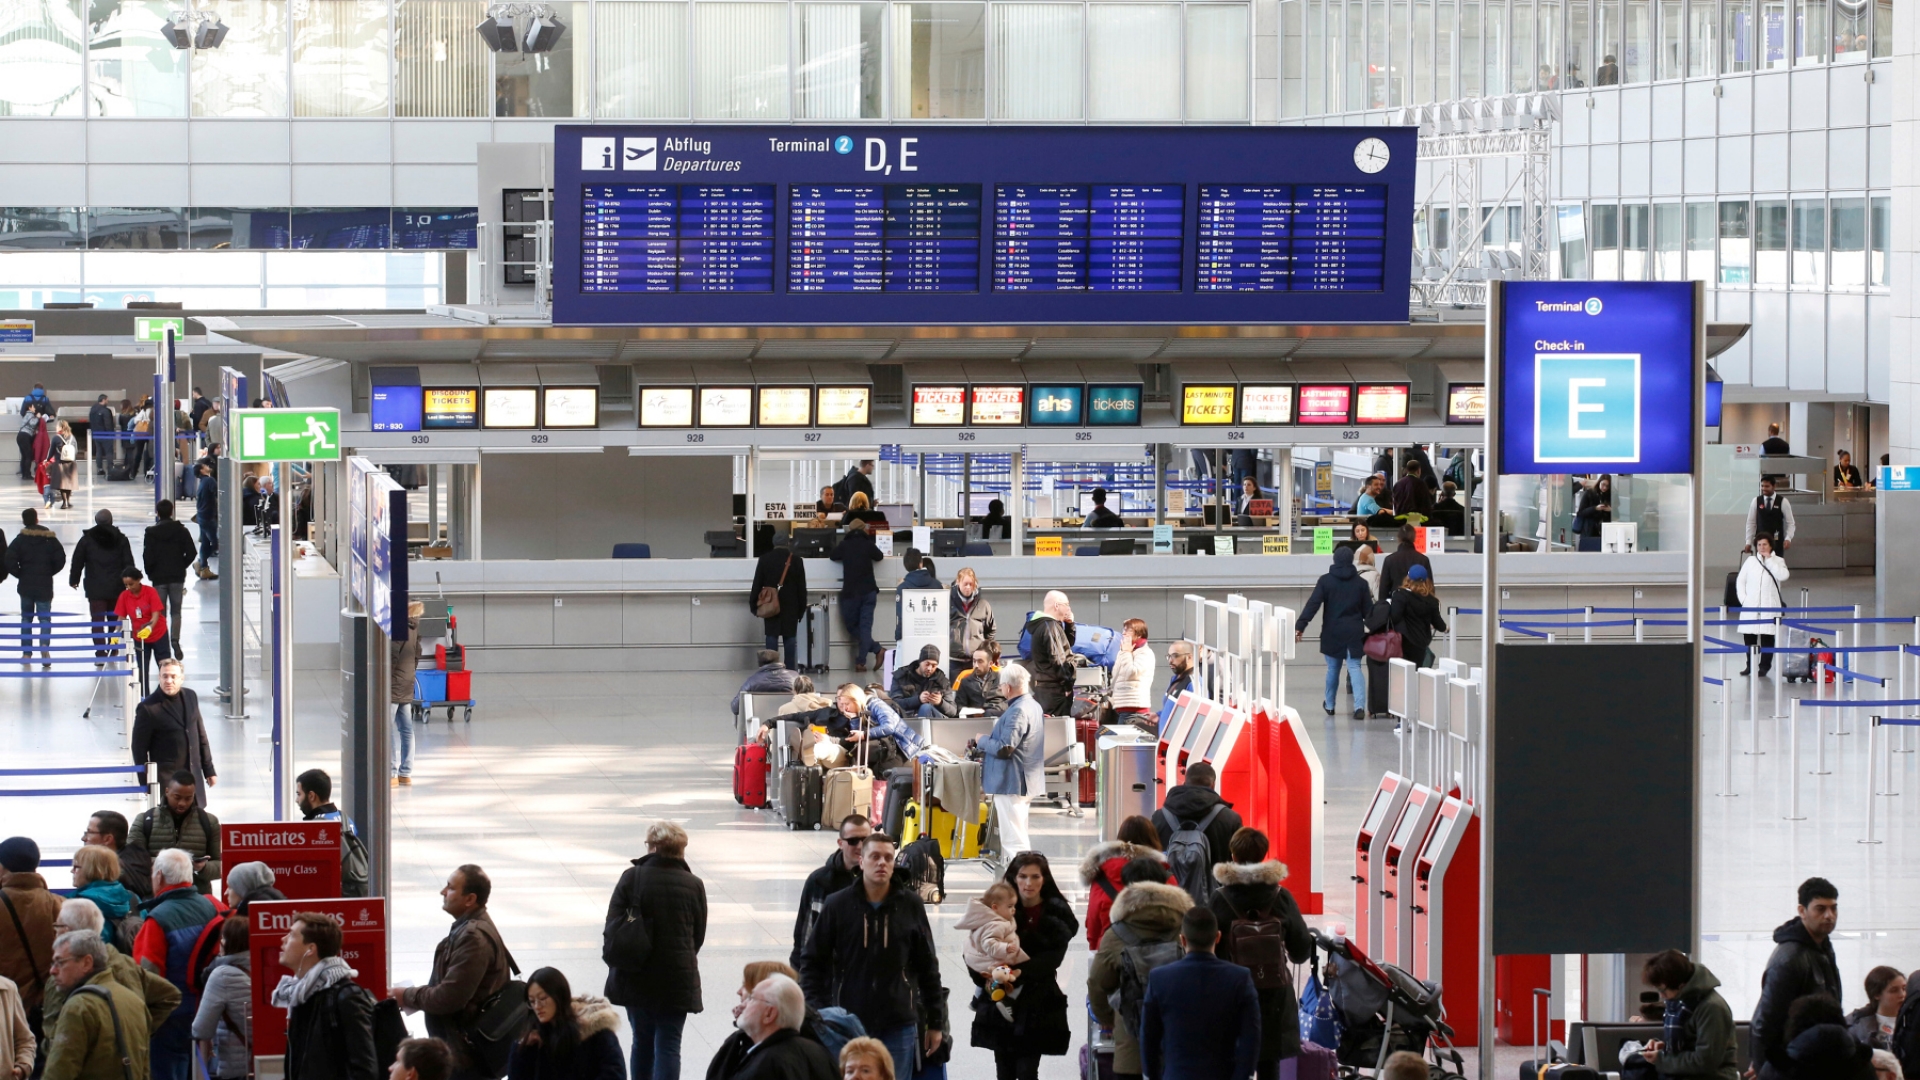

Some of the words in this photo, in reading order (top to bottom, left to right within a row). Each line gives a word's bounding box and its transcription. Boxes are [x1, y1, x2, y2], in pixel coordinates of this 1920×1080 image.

[664, 137, 711, 155] Abflug
[768, 138, 830, 152] Terminal
[838, 138, 848, 151] 2
[864, 138, 892, 176] D,
[900, 138, 918, 171] E
[663, 156, 742, 174] Departures
[1535, 300, 1582, 312] Terminal
[1589, 301, 1598, 312] 2
[1534, 340, 1585, 351] Check-in
[918, 392, 961, 402] TICKETS
[975, 392, 1019, 402] TICKETS
[1038, 395, 1072, 412] ahs
[1093, 398, 1134, 411] tickets
[1568, 378, 1606, 439] E
[1186, 405, 1230, 414] TICKETS
[412, 435, 430, 444] 930
[531, 434, 549, 444] 929
[687, 433, 704, 443] 928
[804, 433, 821, 442] 927
[958, 432, 976, 442] 926
[1075, 432, 1092, 441] 925
[1228, 432, 1244, 440] 924
[1342, 431, 1360, 440] 923
[1264, 545, 1288, 553] TICKETS
[229, 829, 306, 846] Emirates
[294, 865, 317, 874] Class
[340, 949, 359, 959] lass
